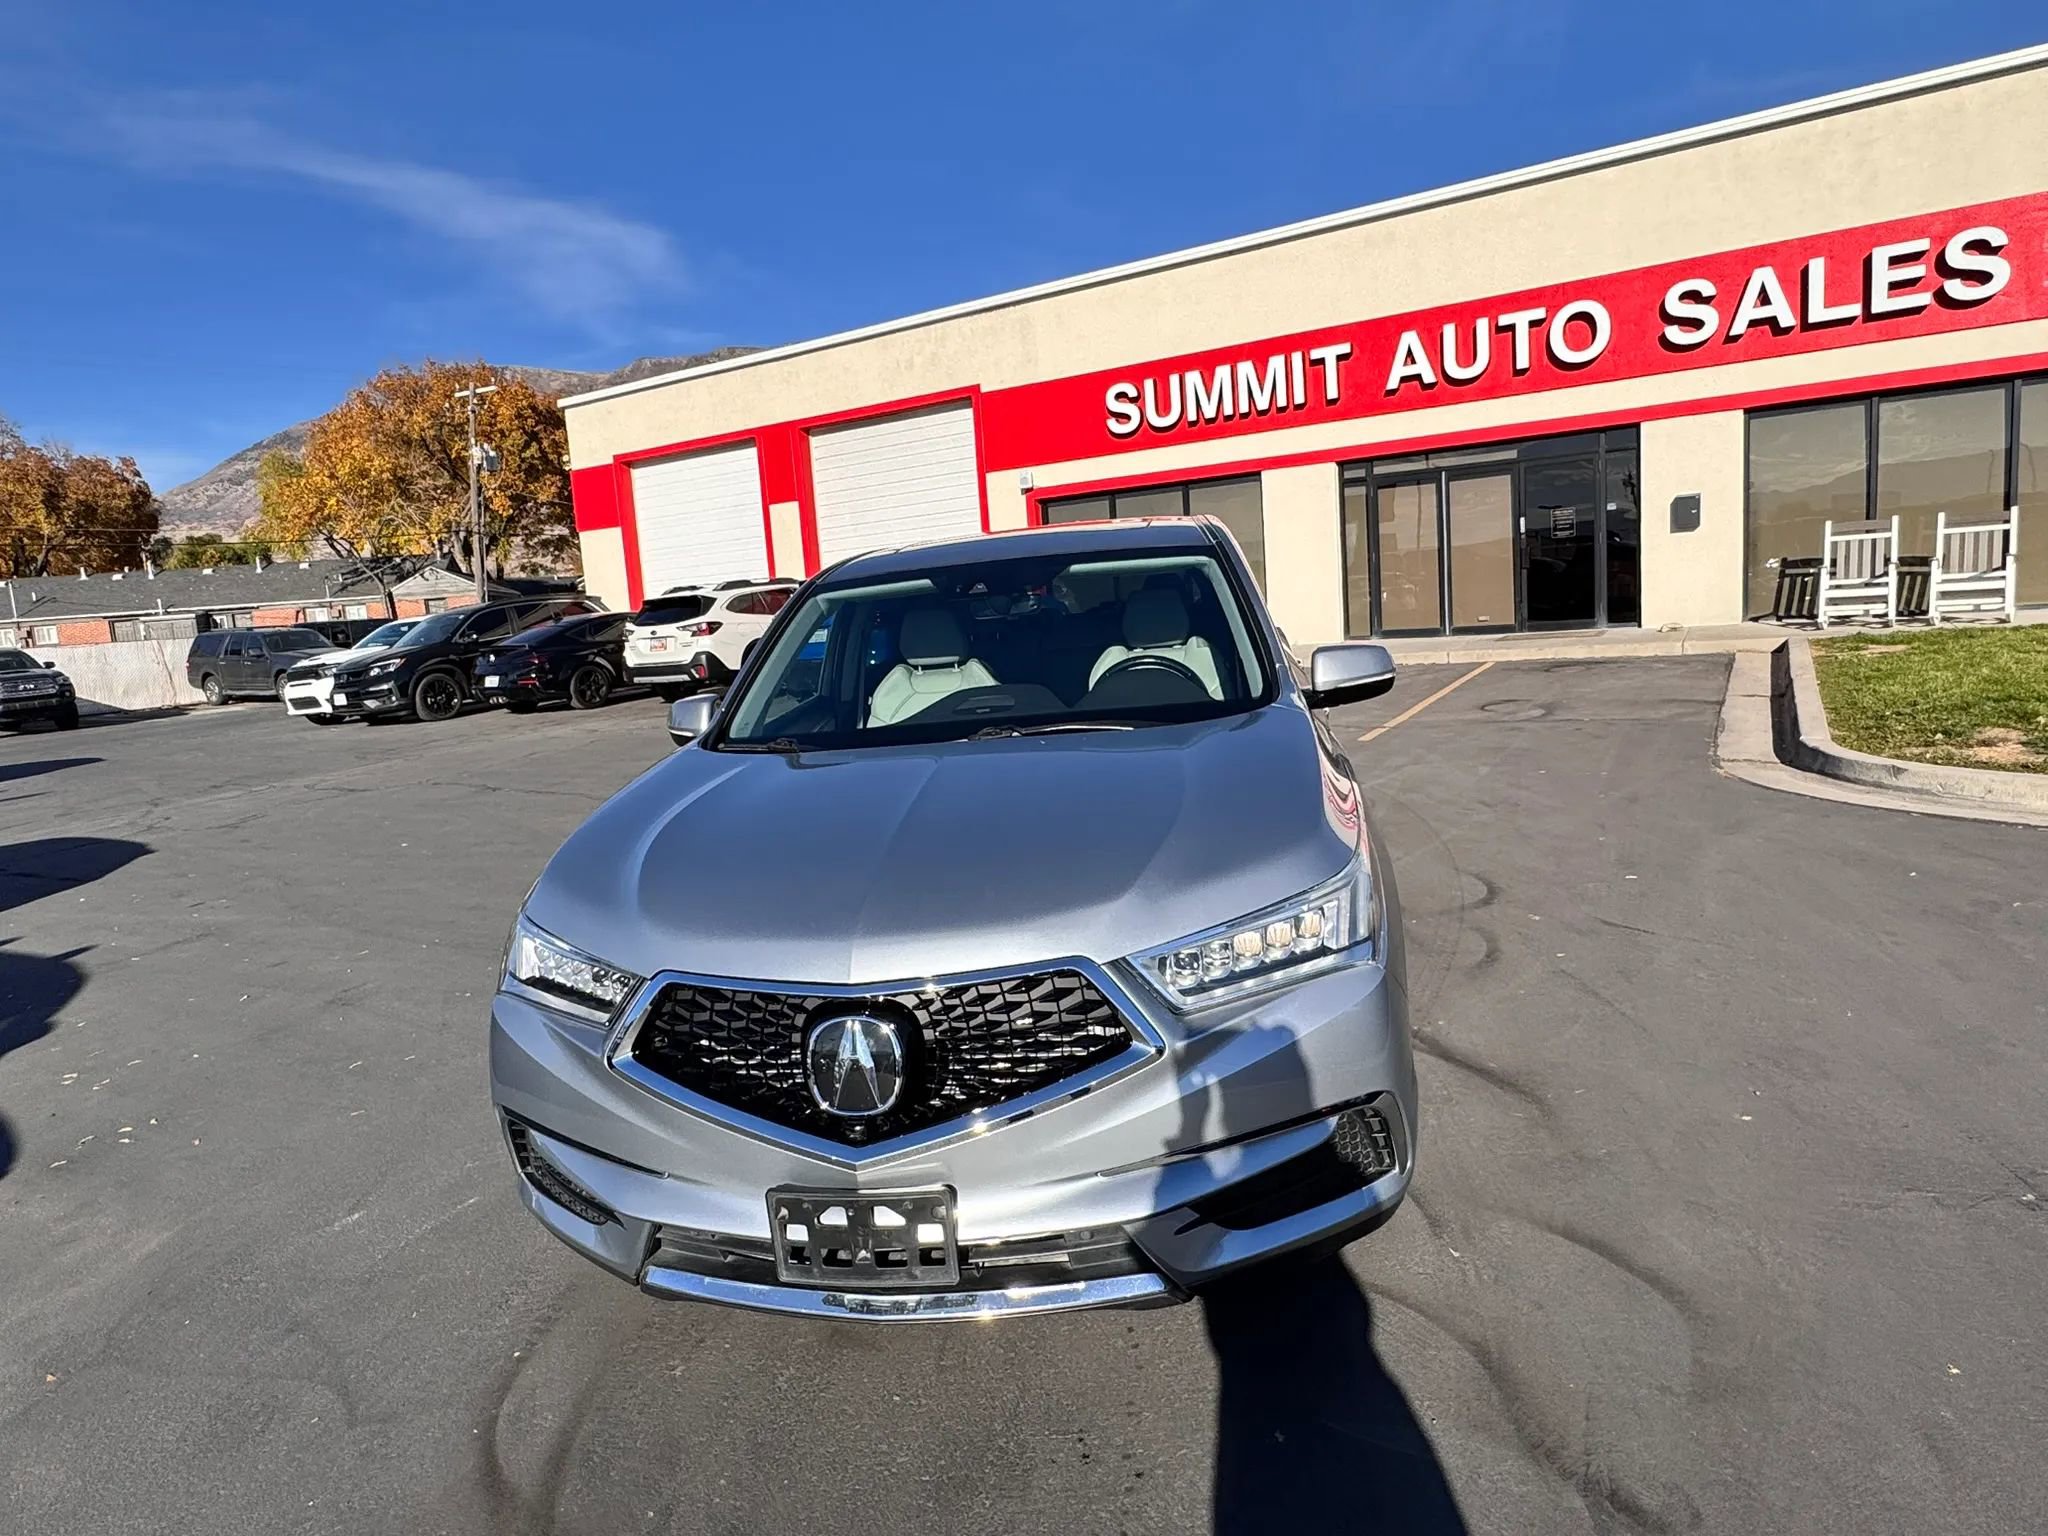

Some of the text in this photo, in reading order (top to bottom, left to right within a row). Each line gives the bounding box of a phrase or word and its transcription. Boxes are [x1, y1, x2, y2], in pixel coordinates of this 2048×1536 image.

[1105, 225, 2012, 435] SUMMIT AUTO SALES
